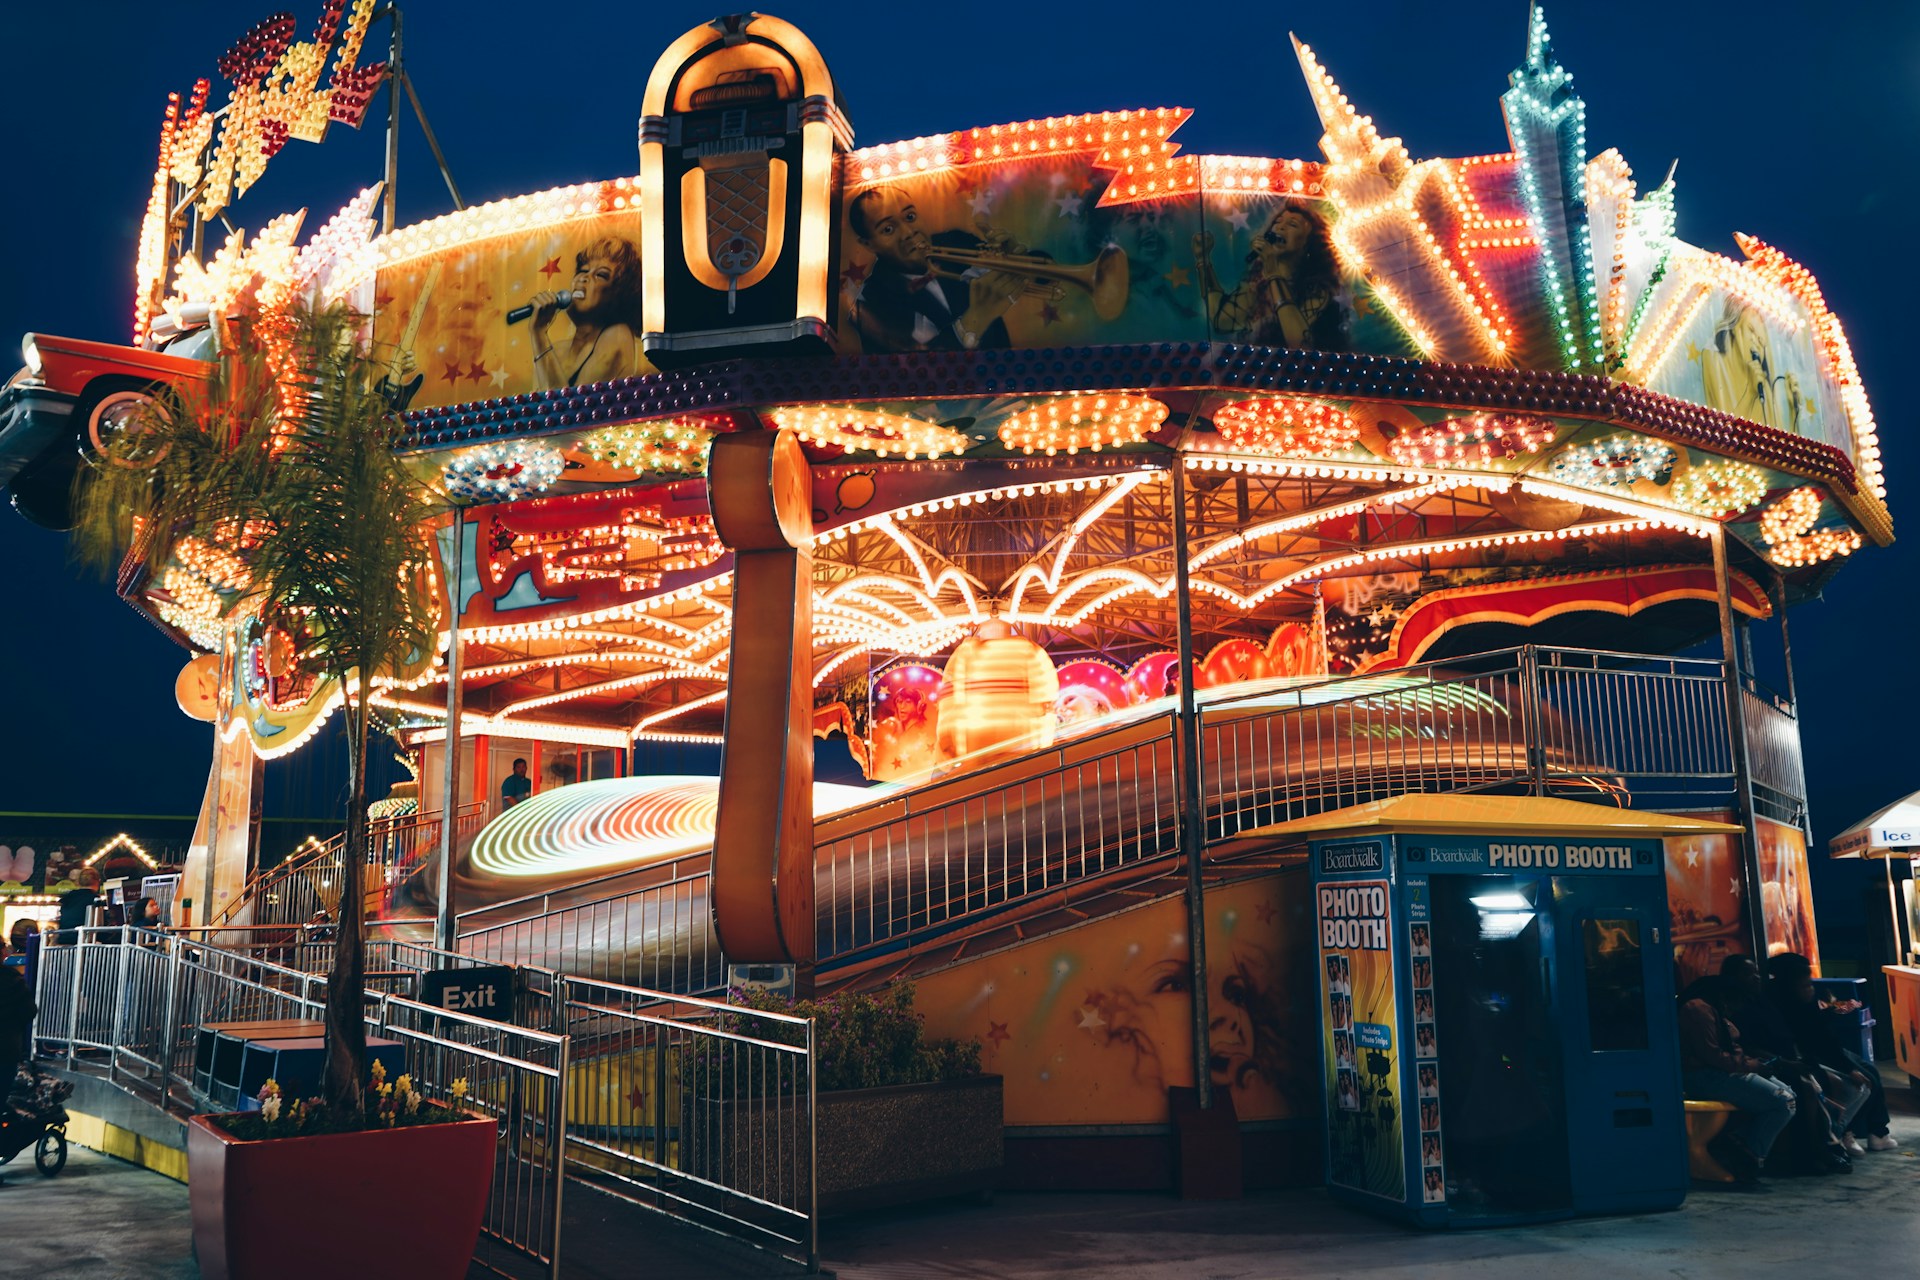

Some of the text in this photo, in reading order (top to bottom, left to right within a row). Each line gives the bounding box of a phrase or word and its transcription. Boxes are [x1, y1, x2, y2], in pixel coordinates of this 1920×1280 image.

[1882, 830, 1912, 841] Ice
[1325, 847, 1379, 870] Boardwalk
[1429, 844, 1632, 869] Boardwalk PHOTO BOOTH
[1320, 887, 1385, 918] PHOTO
[1411, 910, 1426, 918] Strips
[1322, 918, 1388, 950] BOOTH
[442, 984, 496, 1009] Exit
[1361, 1034, 1374, 1044] Photo
[1363, 1026, 1380, 1035] Includes
